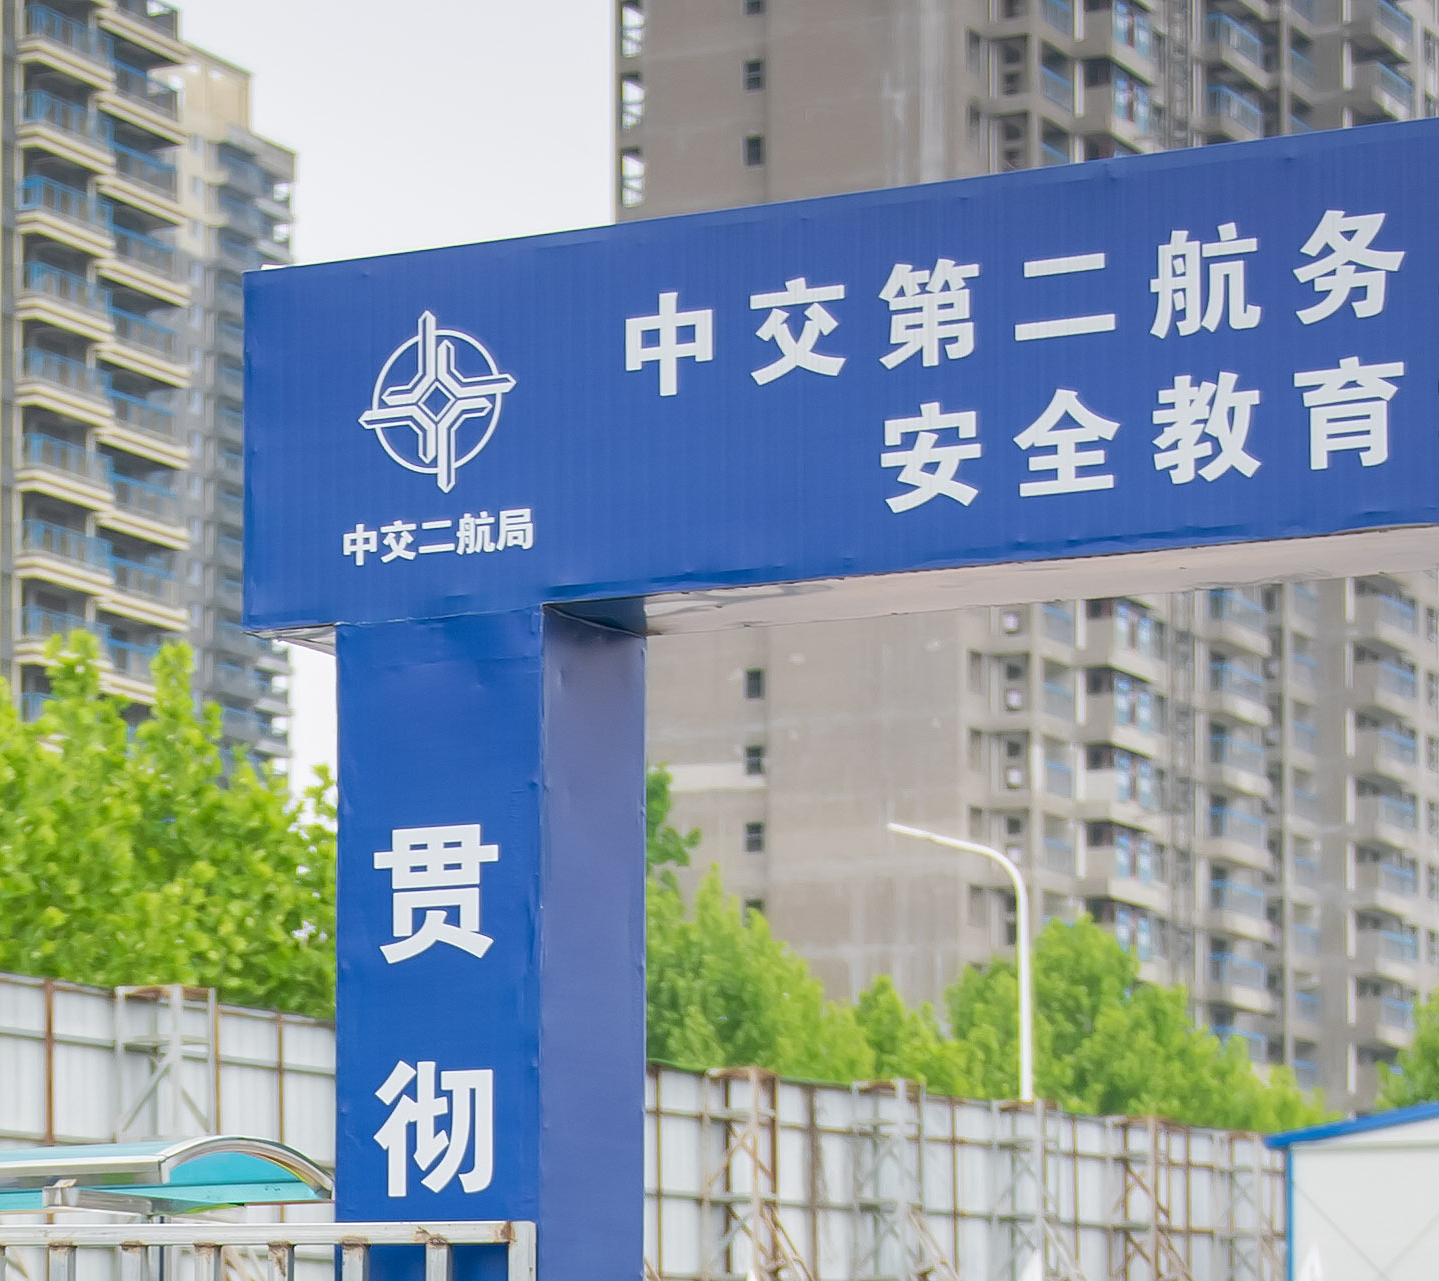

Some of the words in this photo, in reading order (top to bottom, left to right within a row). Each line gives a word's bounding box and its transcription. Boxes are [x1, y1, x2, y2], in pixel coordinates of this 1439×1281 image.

[342, 507, 534, 567] 中交二航局
